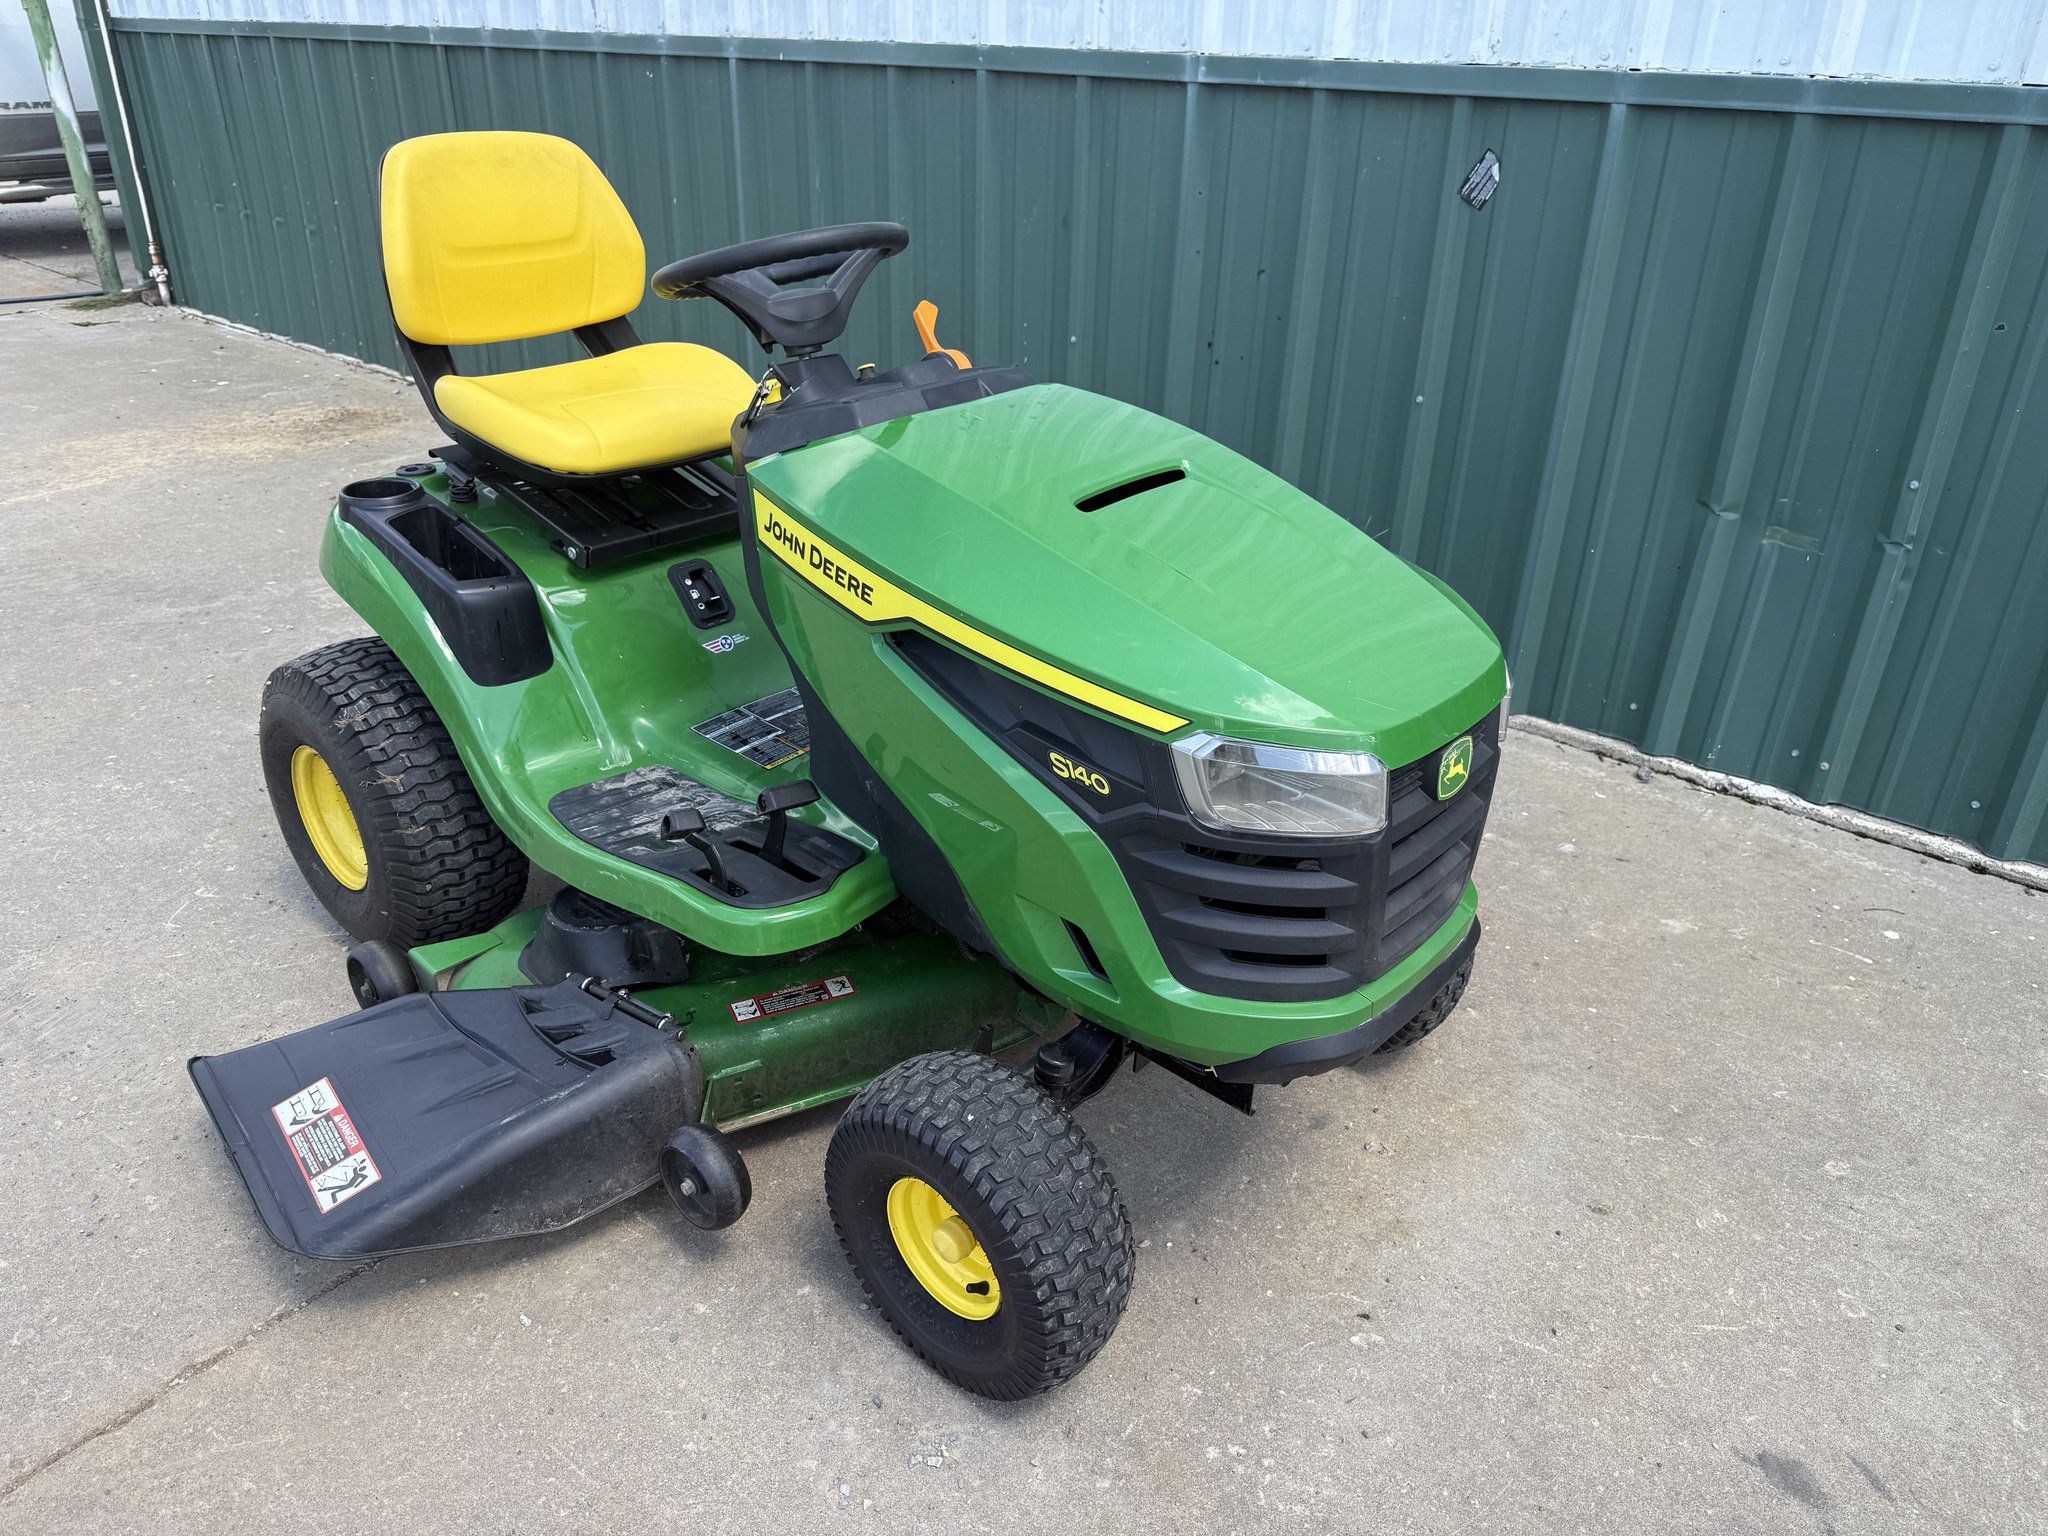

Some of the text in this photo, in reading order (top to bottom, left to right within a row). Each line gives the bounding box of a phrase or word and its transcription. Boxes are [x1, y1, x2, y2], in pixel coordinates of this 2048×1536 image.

[0, 101, 52, 109] RAM
[764, 512, 874, 607] JOHN DEERE
[1049, 751, 1110, 795] S140
[337, 1118, 360, 1149] DANGER
